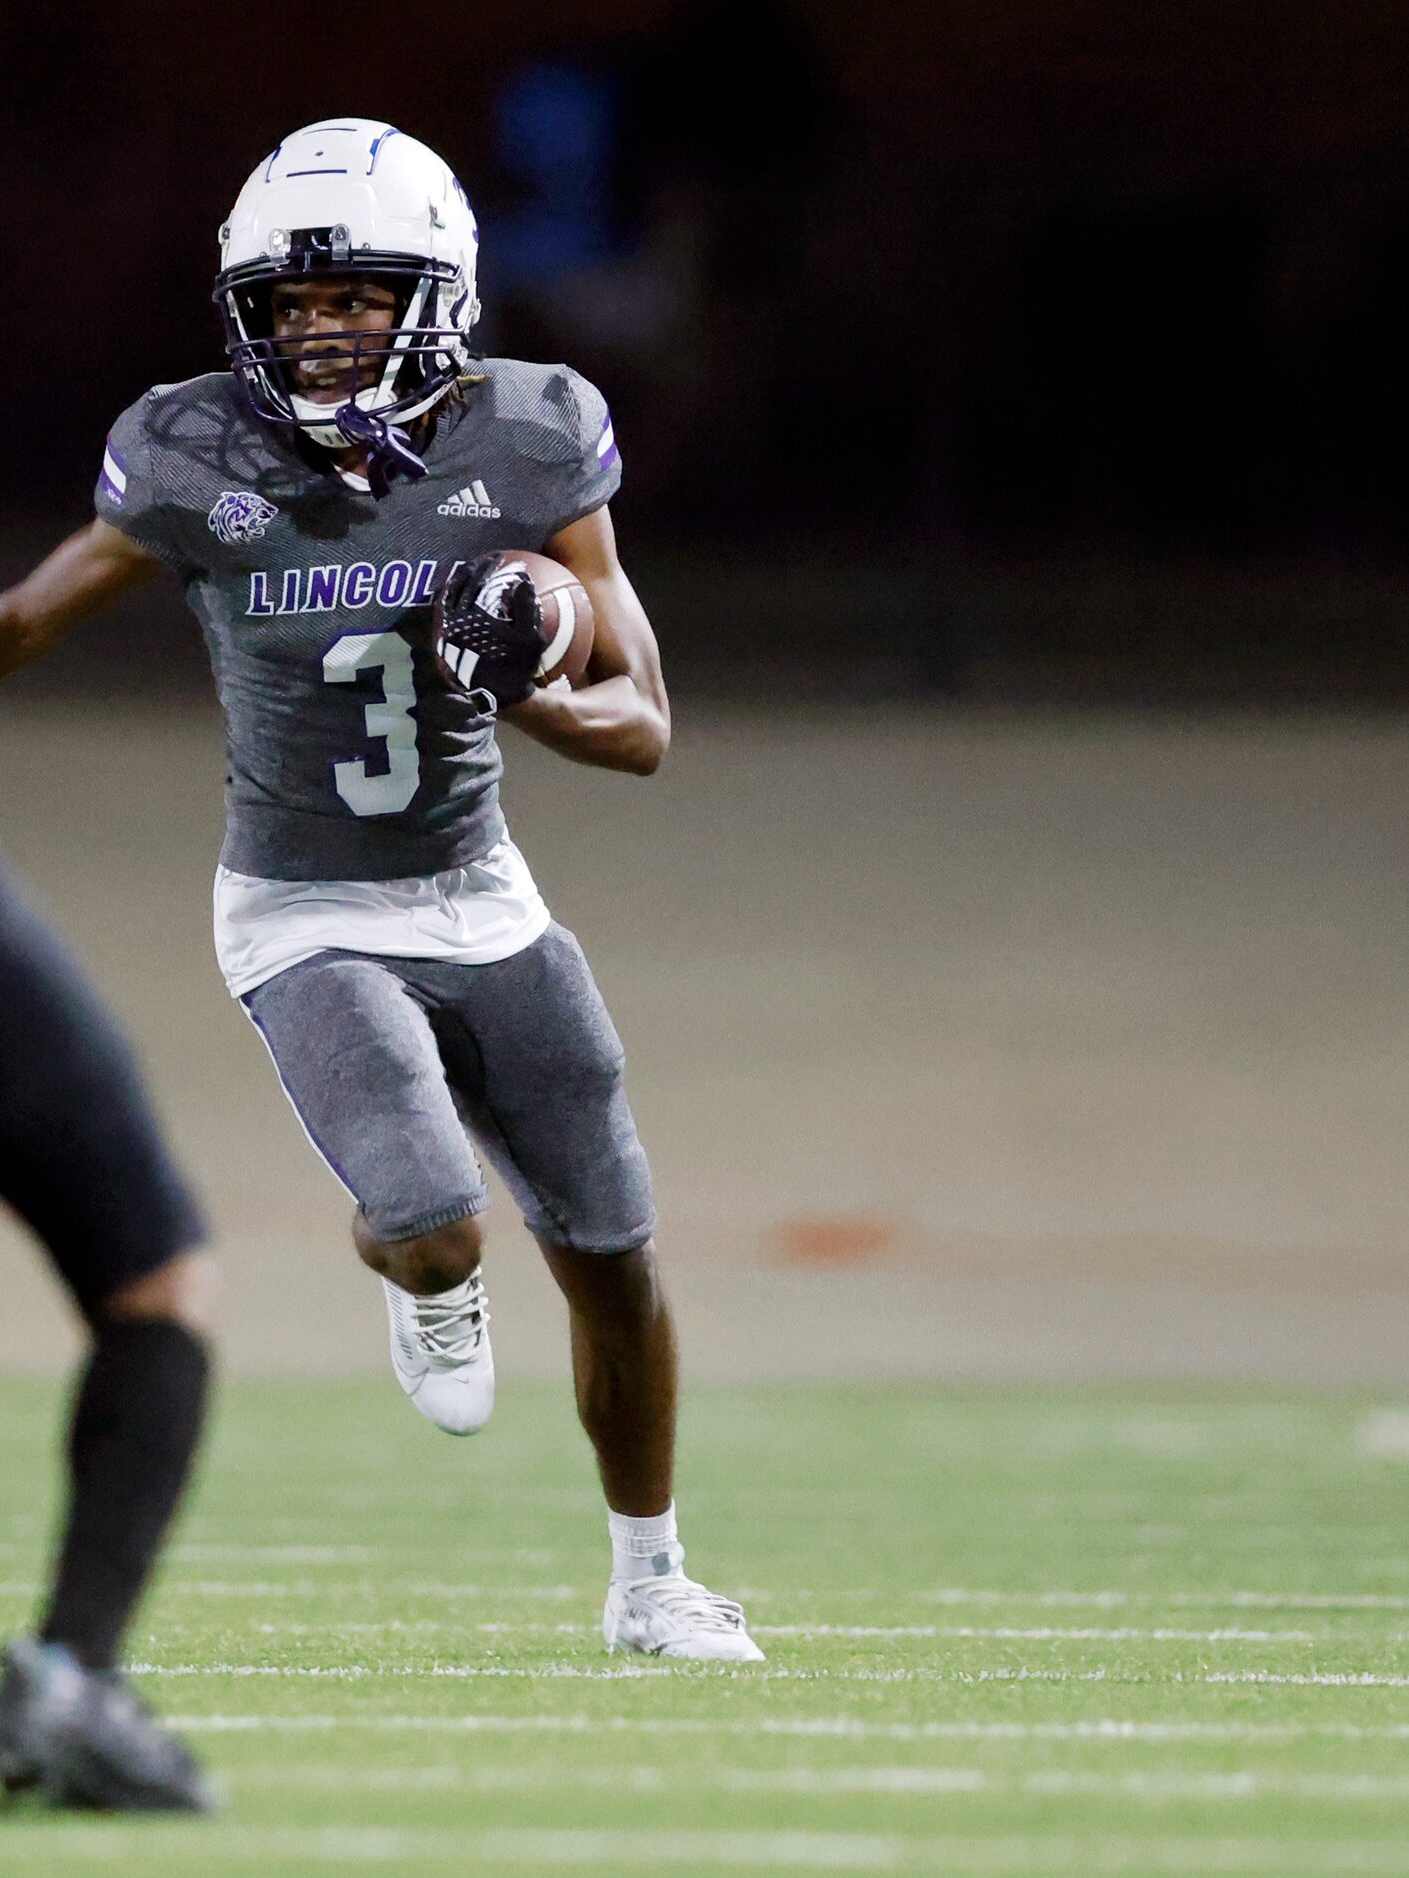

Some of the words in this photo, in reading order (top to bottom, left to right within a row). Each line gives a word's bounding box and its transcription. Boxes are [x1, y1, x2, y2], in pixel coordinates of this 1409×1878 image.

[437, 502, 502, 519] adidas
[244, 560, 467, 616] LINCOL
[321, 629, 422, 818] 3
